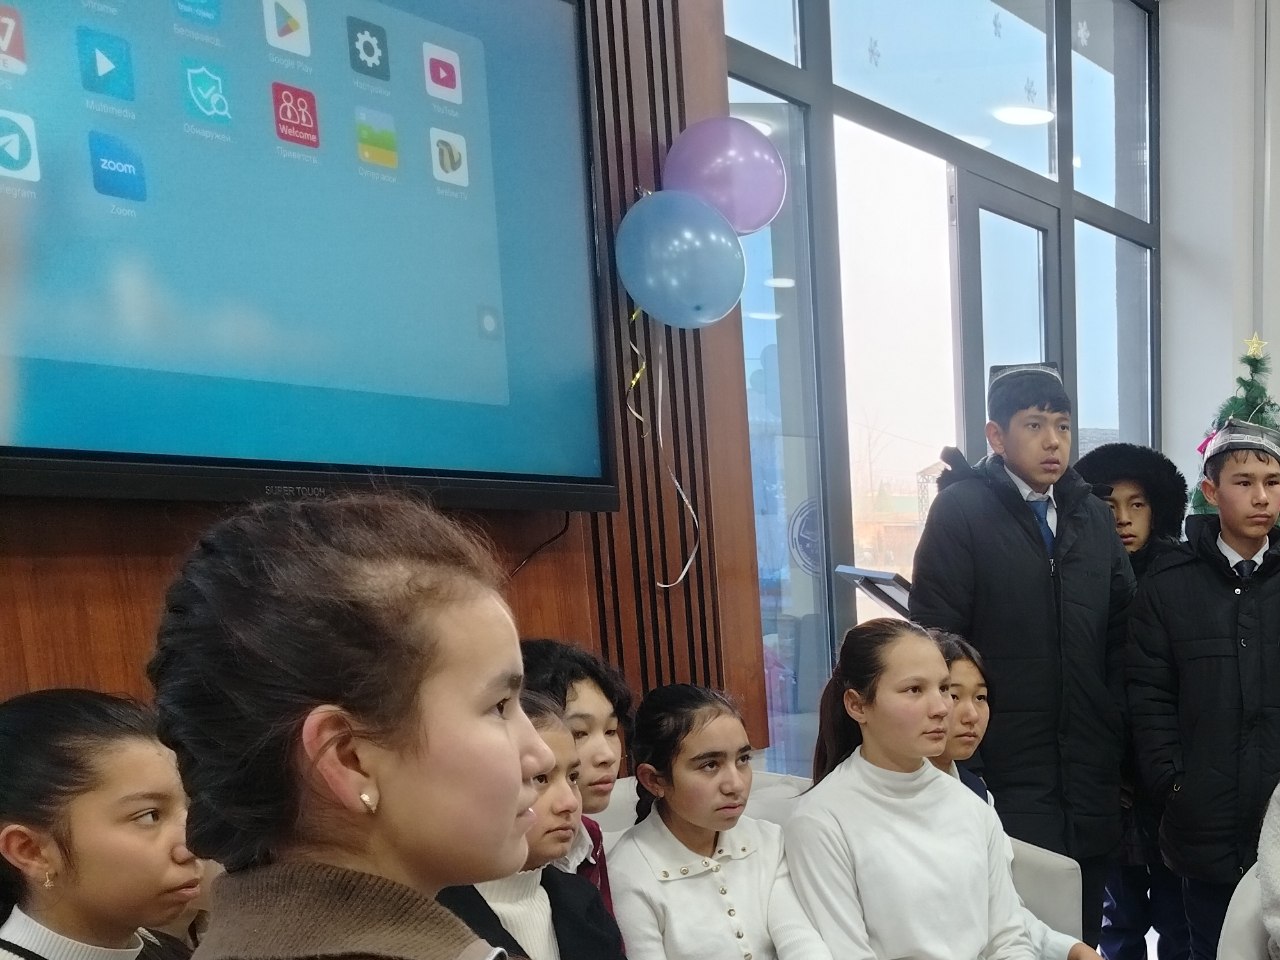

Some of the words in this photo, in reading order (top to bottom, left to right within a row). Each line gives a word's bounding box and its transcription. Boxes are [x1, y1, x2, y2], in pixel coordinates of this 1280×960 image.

[86, 100, 136, 120] Multimedia
[279, 123, 318, 143] Welcome
[100, 158, 136, 175] zoom
[110, 204, 136, 217] Zoom
[296, 486, 326, 497] TOUCH
